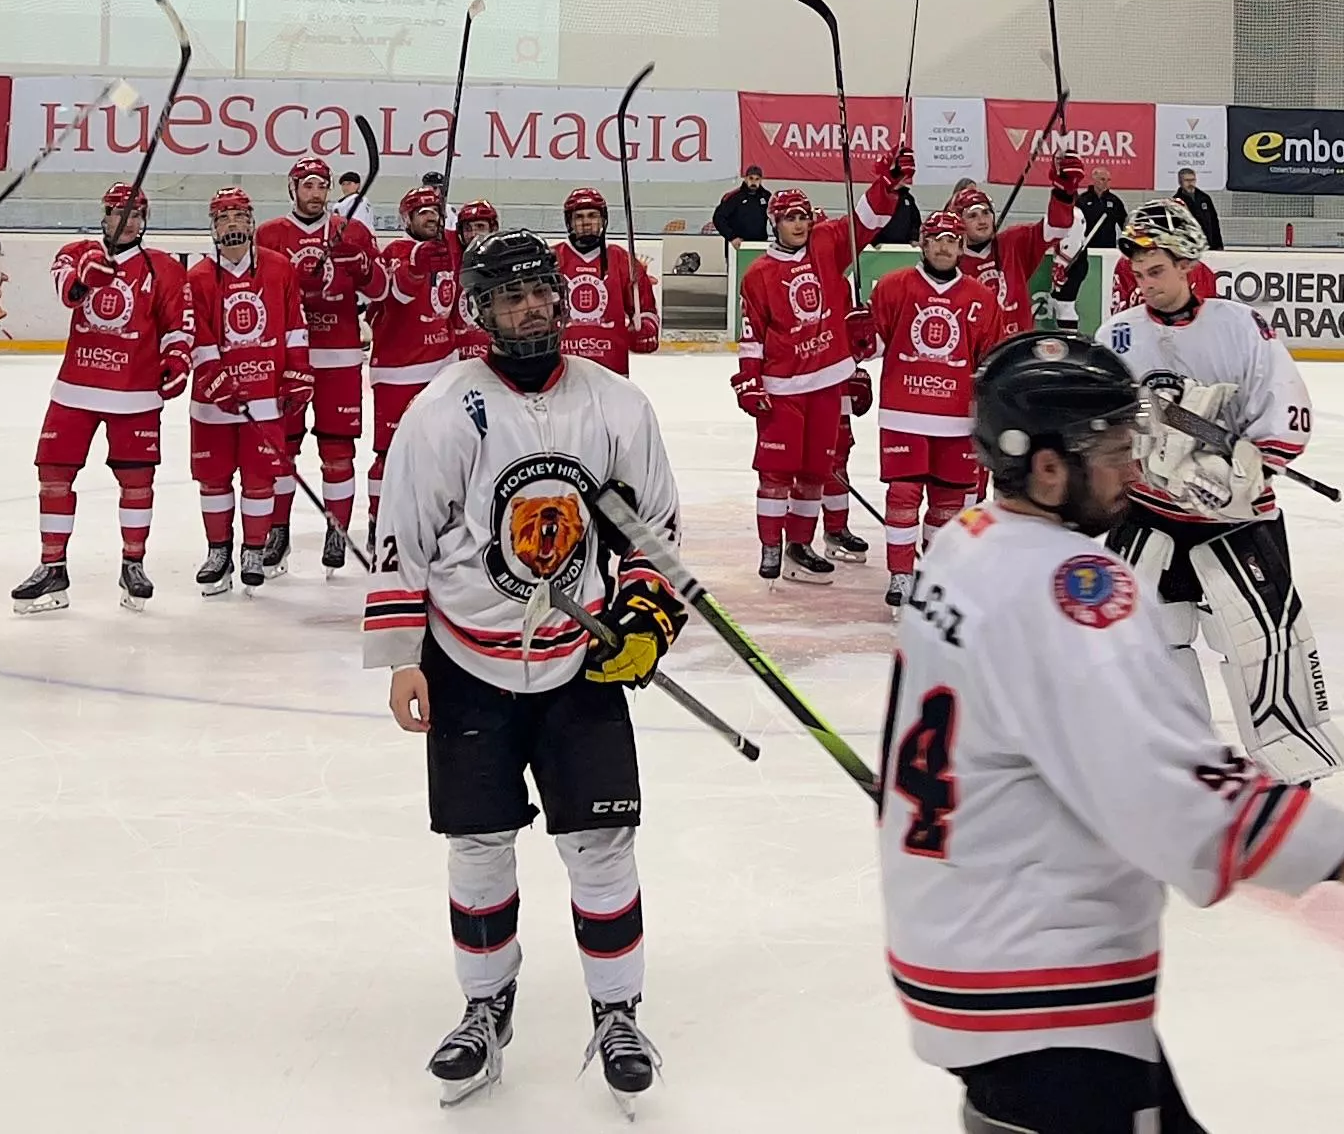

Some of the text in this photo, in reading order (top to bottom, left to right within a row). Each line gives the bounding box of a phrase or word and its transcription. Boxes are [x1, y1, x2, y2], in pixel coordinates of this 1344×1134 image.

[782, 122, 892, 152] AMBAR
[1029, 129, 1137, 158] AMBAR
[511, 260, 542, 272] CCM
[923, 309, 952, 321] HIELO
[967, 301, 982, 323] C
[228, 359, 276, 377] uesca
[1287, 404, 1312, 433] 20
[499, 464, 590, 498] HOCKEY HIELO
[496, 557, 584, 599] MAJADONDA
[1307, 649, 1331, 714] VAUGHN
[878, 650, 961, 860] 4
[591, 800, 639, 814] CCM
